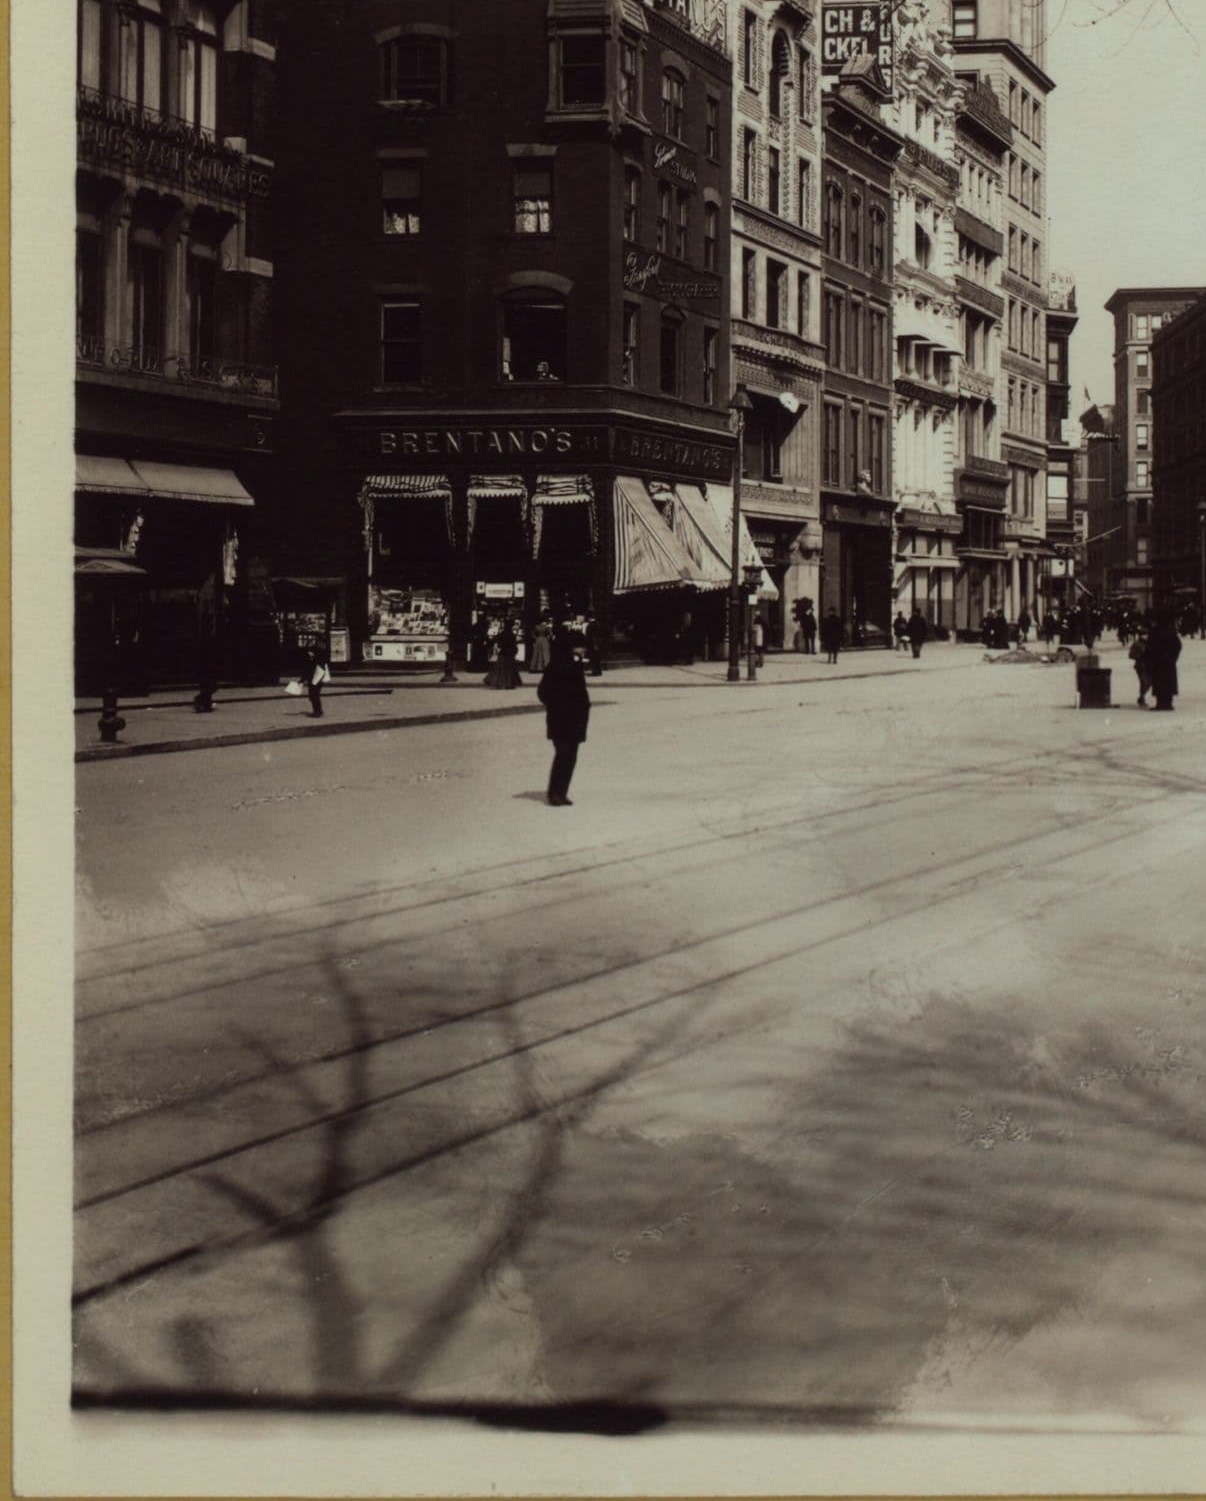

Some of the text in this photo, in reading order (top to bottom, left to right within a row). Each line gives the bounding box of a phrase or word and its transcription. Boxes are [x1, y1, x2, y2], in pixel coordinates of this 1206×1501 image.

[824, 8, 876, 34] CH &
[379, 427, 573, 454] BRENTANO'S
